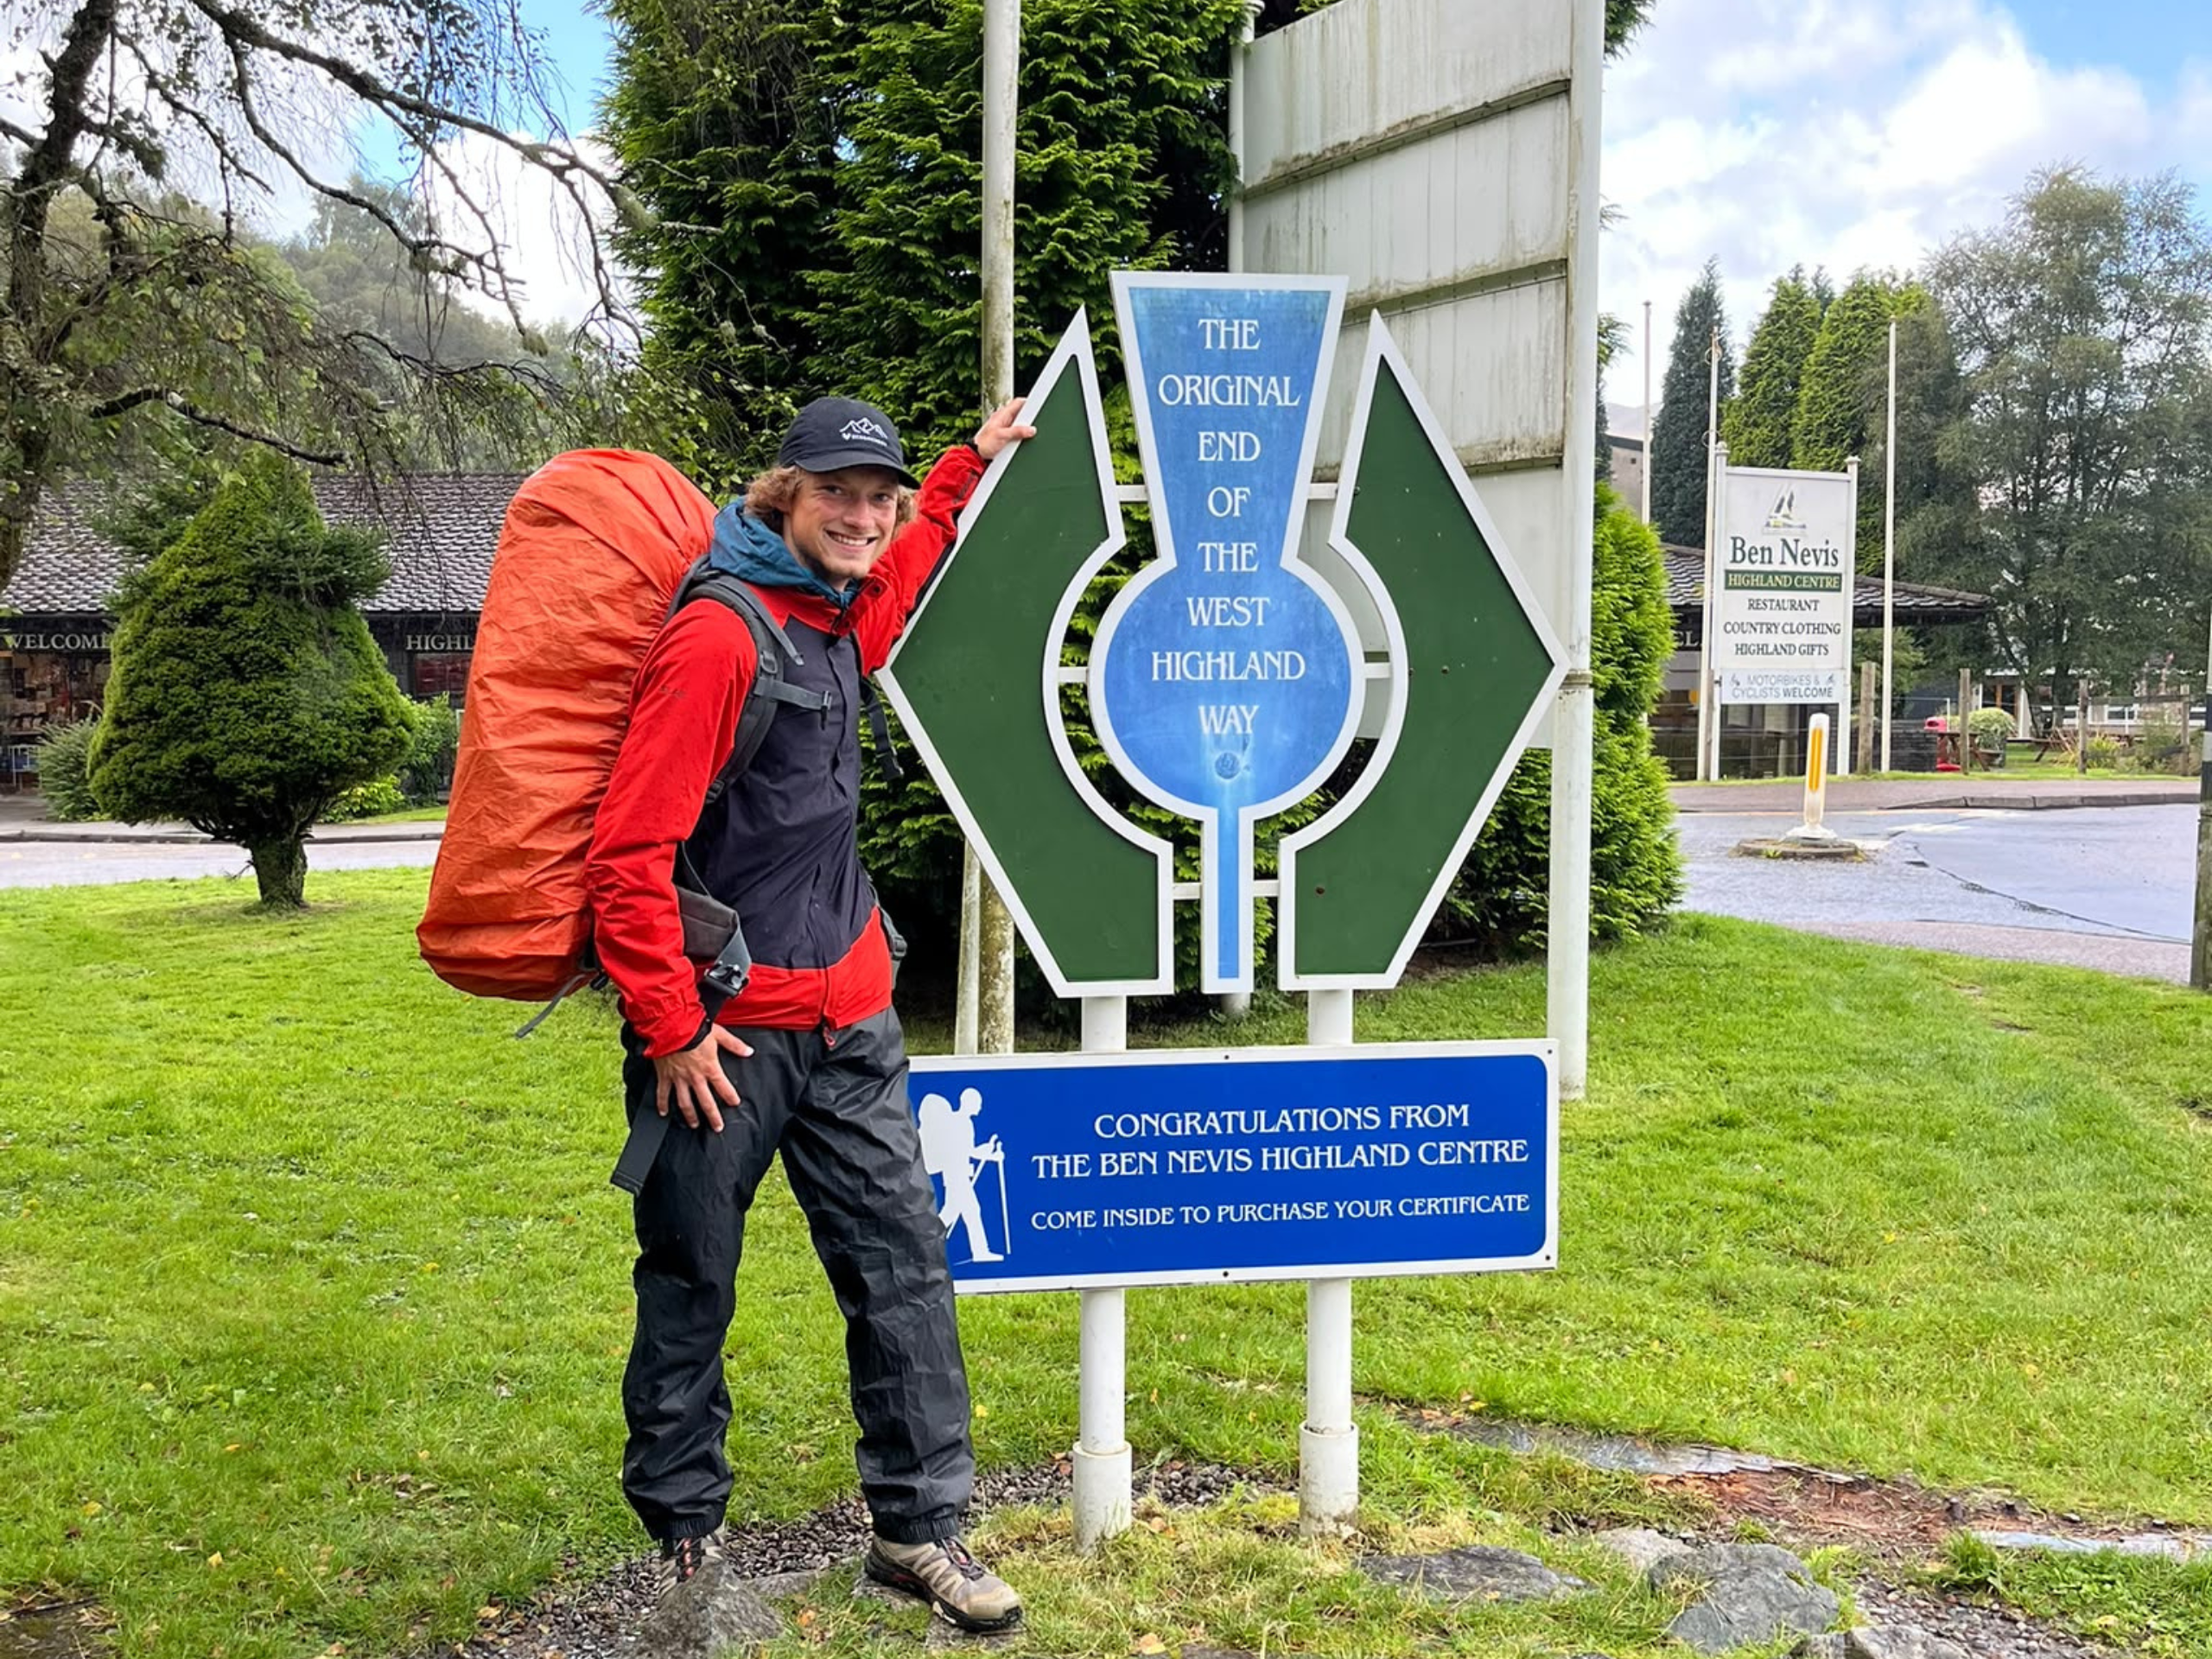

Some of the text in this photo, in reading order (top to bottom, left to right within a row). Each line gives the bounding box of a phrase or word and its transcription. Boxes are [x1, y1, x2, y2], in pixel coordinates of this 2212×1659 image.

[1198, 318, 1261, 351] THE
[1158, 374, 1301, 407] ORIGINAL
[1198, 431, 1262, 462] END
[1207, 486, 1251, 518] OF
[1198, 542, 1258, 572] THE
[1729, 536, 1840, 567] Ben Nevis
[1728, 574, 1840, 589] HIGHLAND CENTRE
[1186, 596, 1270, 627] WEST
[1747, 598, 1820, 612] RESTAURANT
[1723, 621, 1841, 636] COUNTRY CLOTHING
[1734, 643, 1829, 656] HIGHLAND GIFTS
[1151, 651, 1306, 682] HIGHLAND
[1747, 673, 1811, 686] MOTORBIKES
[1732, 687, 1834, 699] CYCLISTS WELCOME
[1198, 704, 1261, 735] WAY
[1094, 1103, 1470, 1139] CONGRATULATIONS FROM
[1032, 1139, 1529, 1179] THE BEN NEVIS HIGHLAND CENTRE
[1031, 1194, 1530, 1230] COME INSIDE TO PURCHASE YOUR CERTIFICATE
